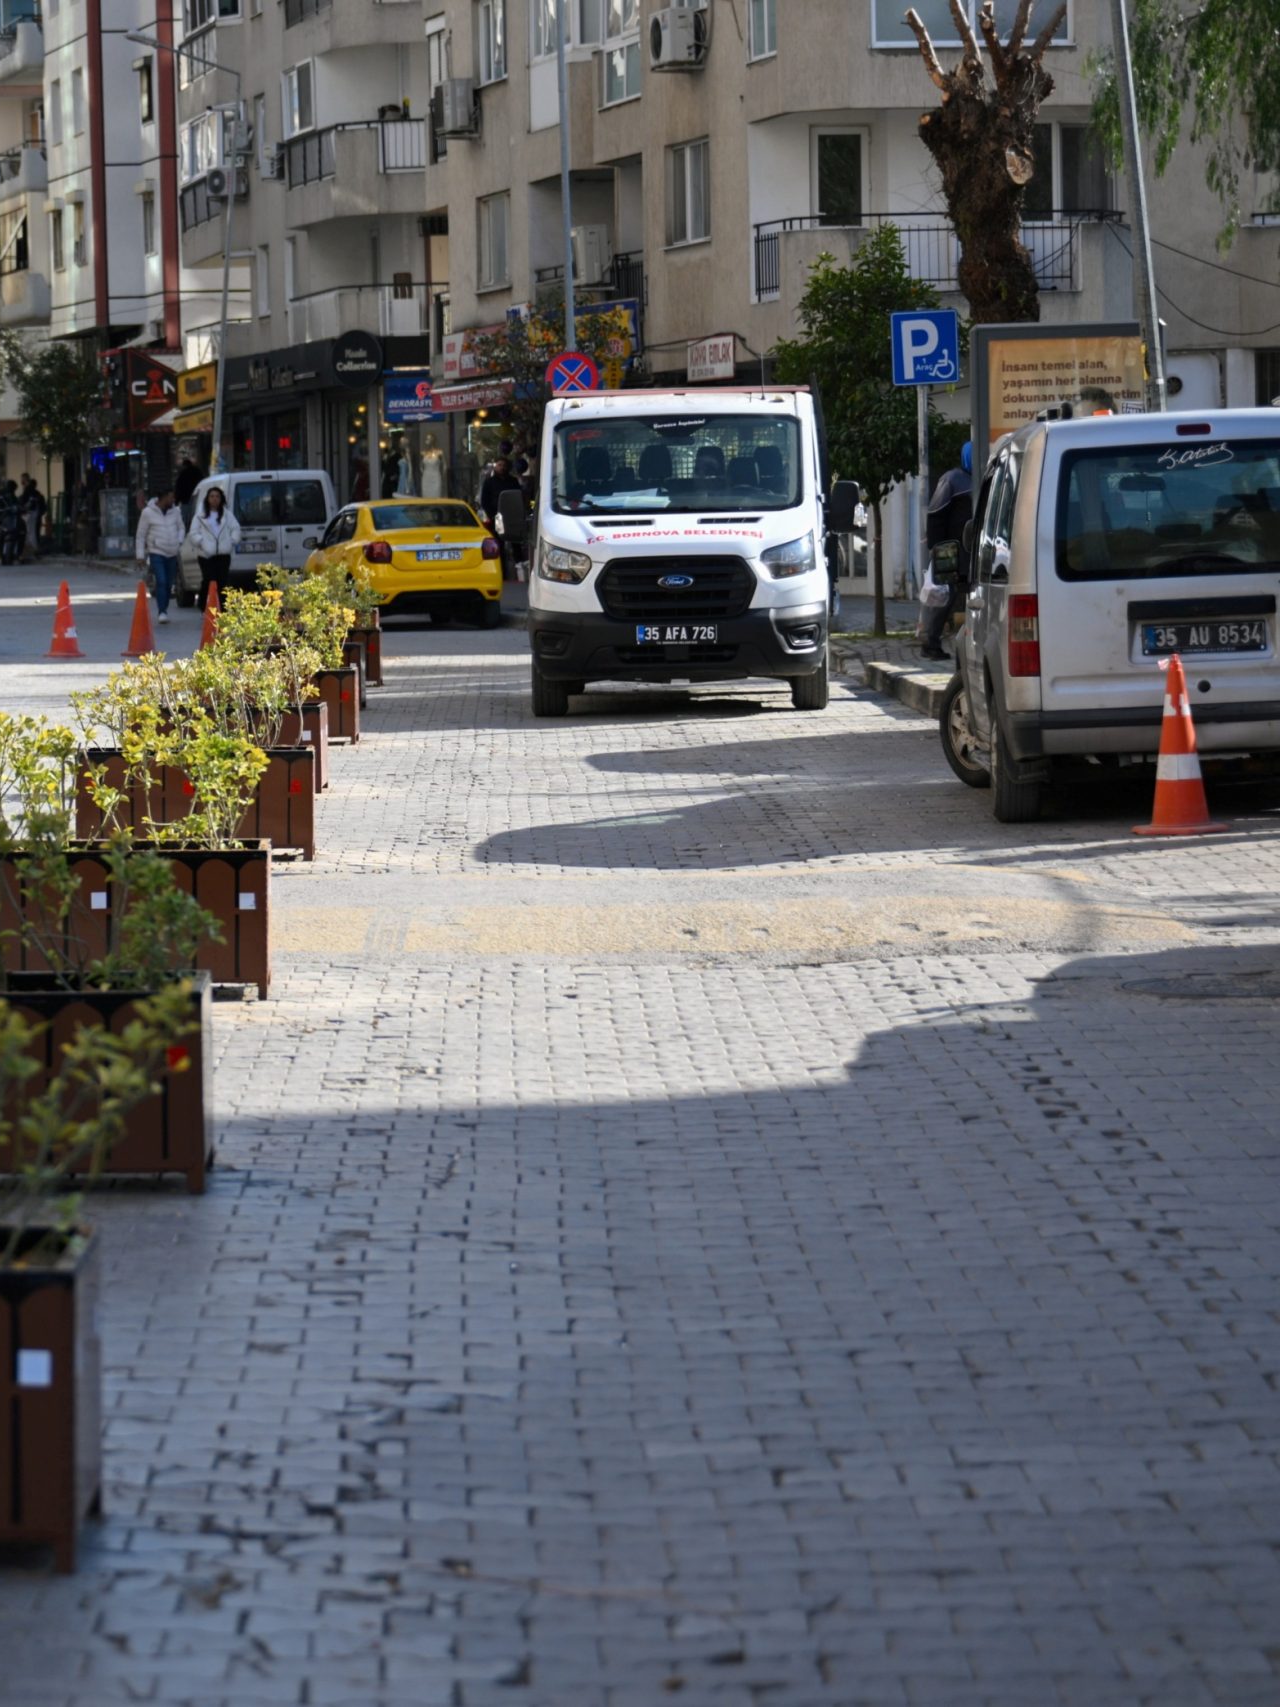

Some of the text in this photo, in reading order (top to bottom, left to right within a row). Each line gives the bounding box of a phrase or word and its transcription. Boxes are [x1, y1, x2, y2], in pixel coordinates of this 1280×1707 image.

[900, 319, 939, 380] P
[1002, 360, 1108, 373] İnsanı temel alan,
[1002, 375, 1123, 390] yaşamın her alanına
[1002, 393, 1056, 404] dokunan
[612, 529, 680, 540] BORNOVA
[683, 529, 763, 539] BELEDİYESİ
[644, 626, 715, 641] 35 AFA 726
[1155, 625, 1261, 648] 35 AU 8534
